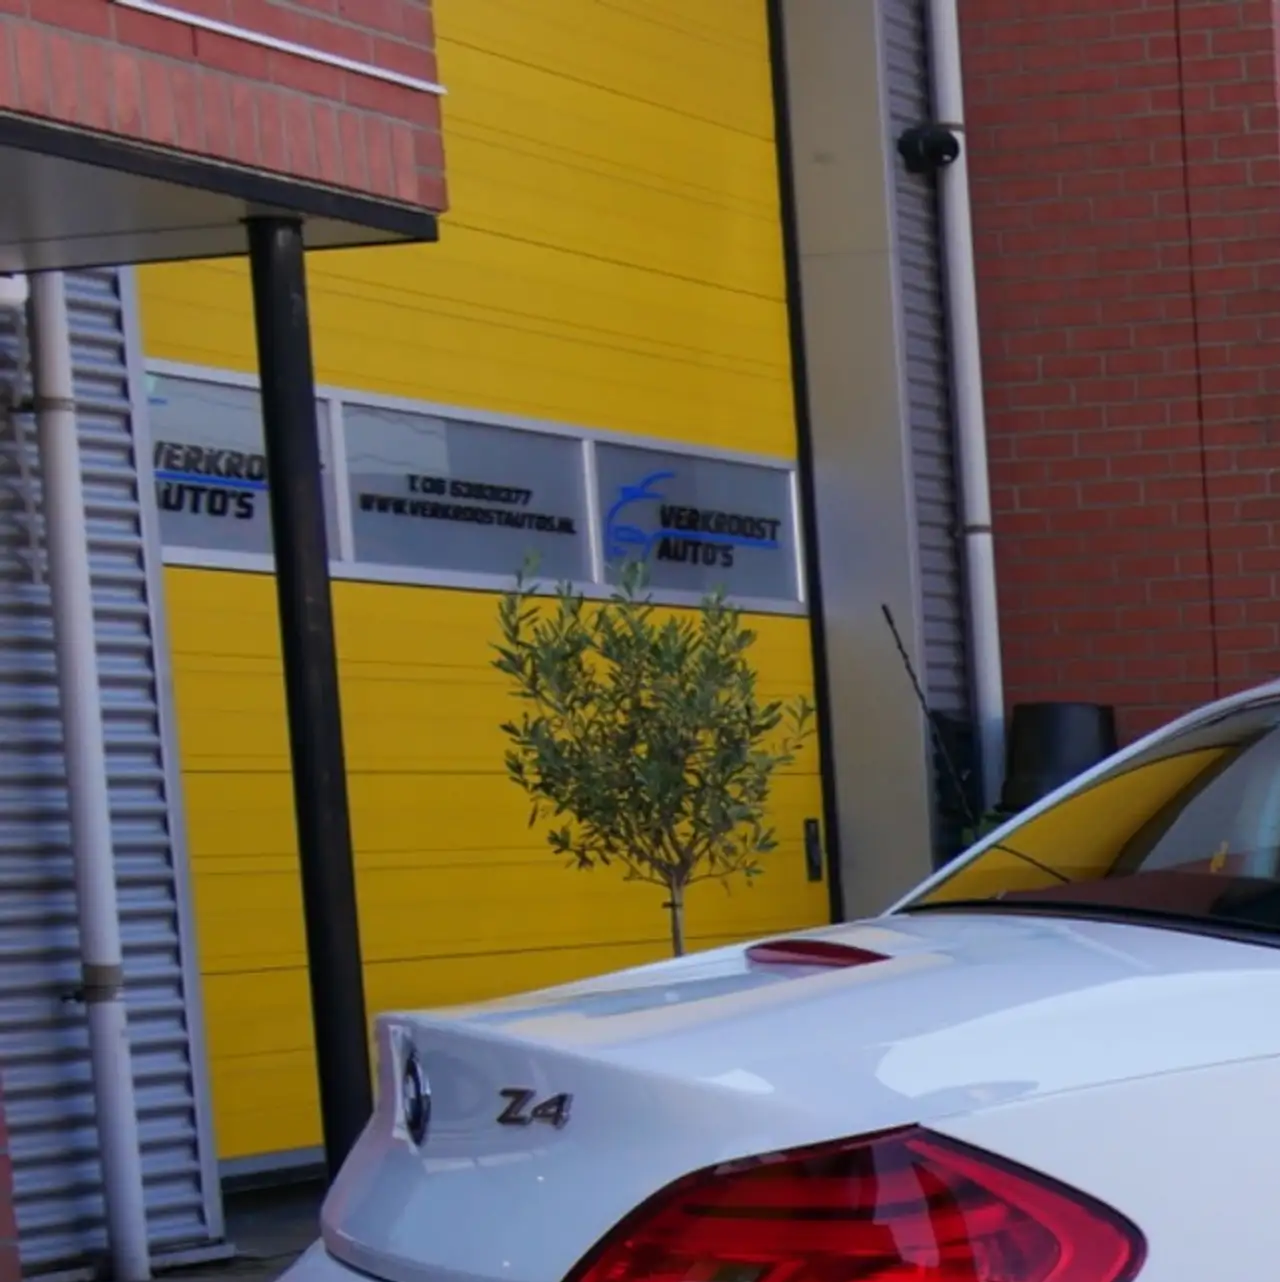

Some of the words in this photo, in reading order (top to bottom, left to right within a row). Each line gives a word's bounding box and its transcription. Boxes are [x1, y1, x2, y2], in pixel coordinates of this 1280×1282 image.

[660, 504, 781, 541] VERKROOST
[657, 537, 735, 568] AUTO'S
[496, 1087, 572, 1130] Z4
